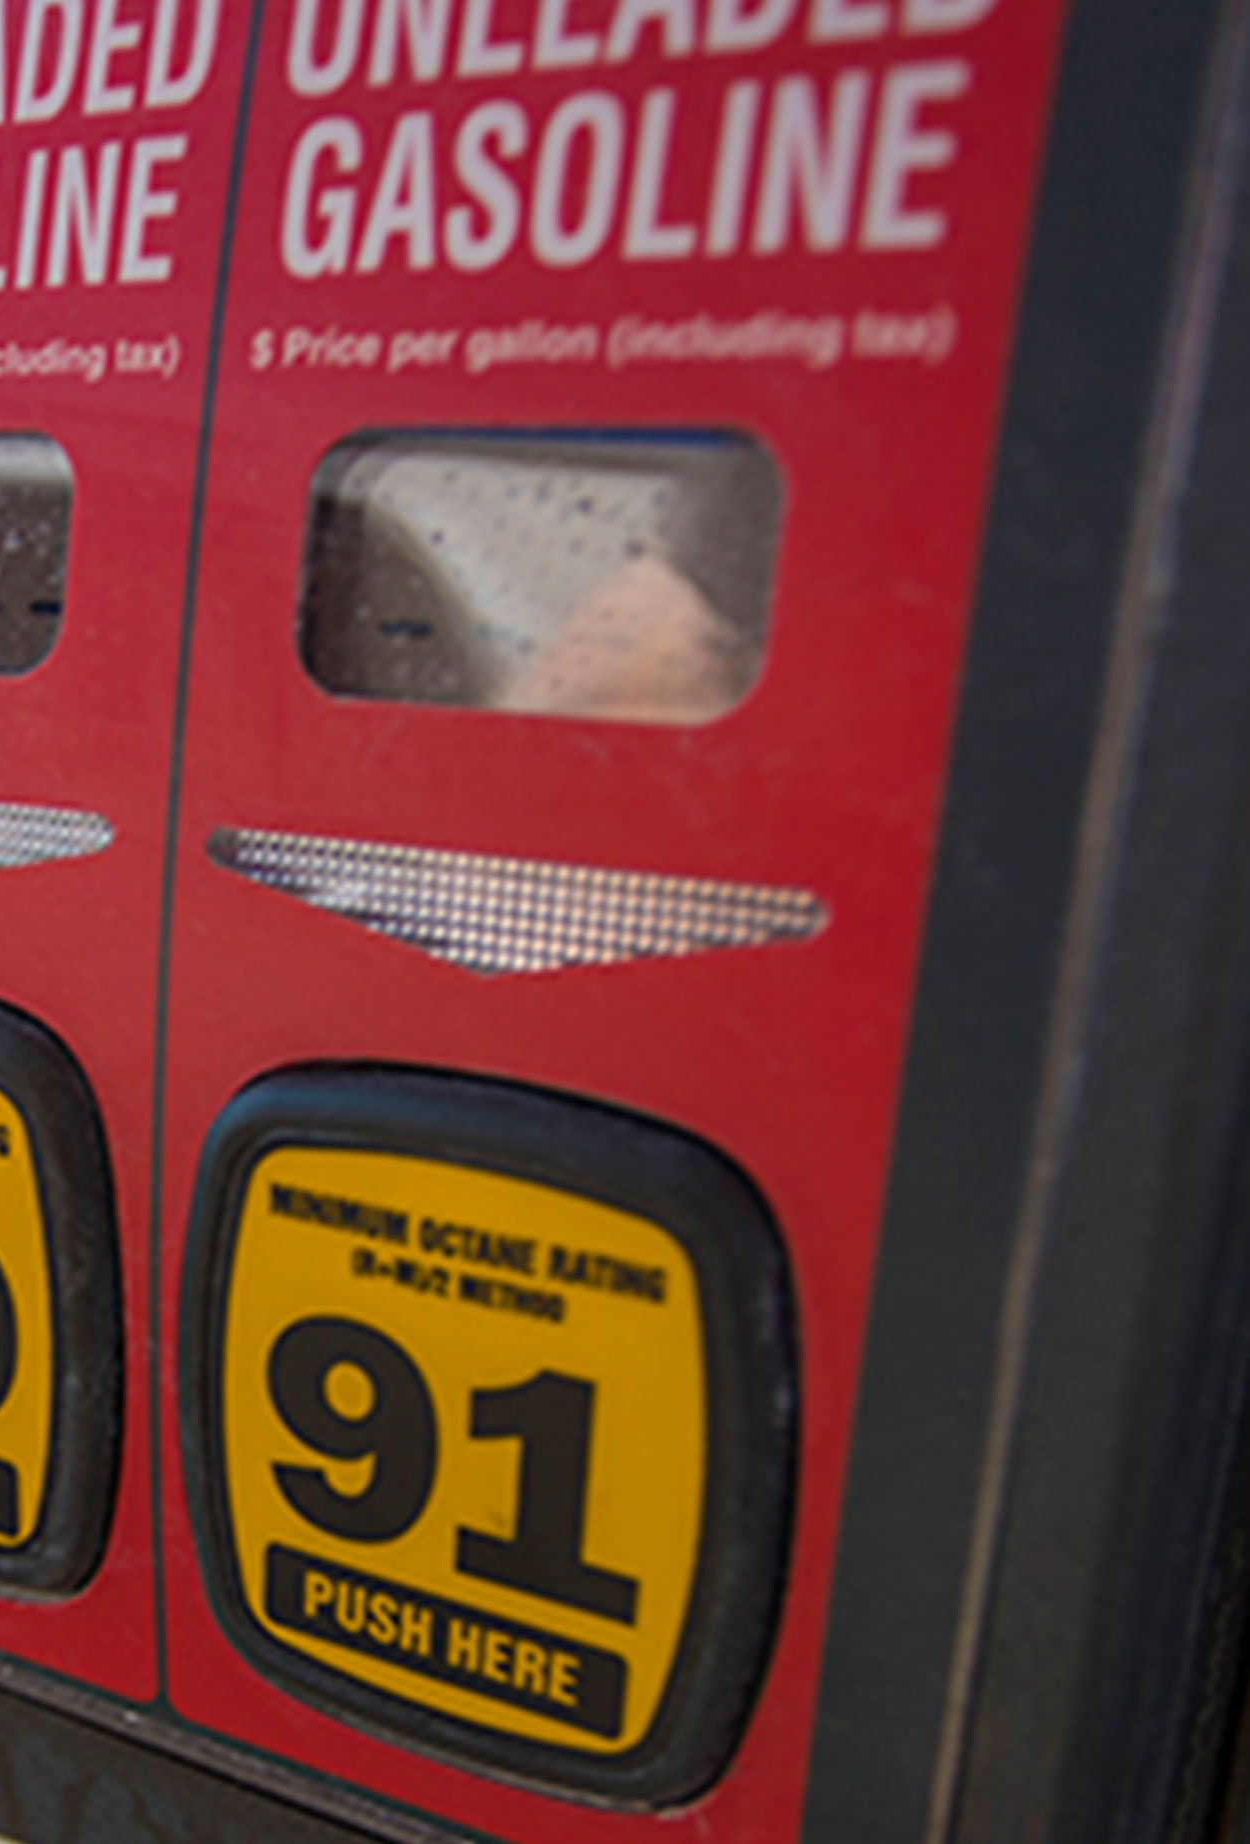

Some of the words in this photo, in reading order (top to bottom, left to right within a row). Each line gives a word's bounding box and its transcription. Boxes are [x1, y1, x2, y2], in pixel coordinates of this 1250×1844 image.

[280, 59, 971, 280] GASOLINE
[114, 334, 180, 380] tax)
[250, 327, 276, 370] $
[281, 326, 381, 368] Price
[386, 329, 455, 374] per
[464, 318, 599, 375] gallon
[605, 309, 844, 371] (including
[851, 305, 957, 367] tax)
[269, 1182, 410, 1246] MINIMUM
[419, 1217, 537, 1277] OCTANE
[548, 1244, 667, 1305] RATING
[458, 1273, 568, 1325] METHOD
[266, 1314, 641, 1629] 91
[303, 1571, 432, 1661] PUSH
[447, 1623, 582, 1709] HERE
